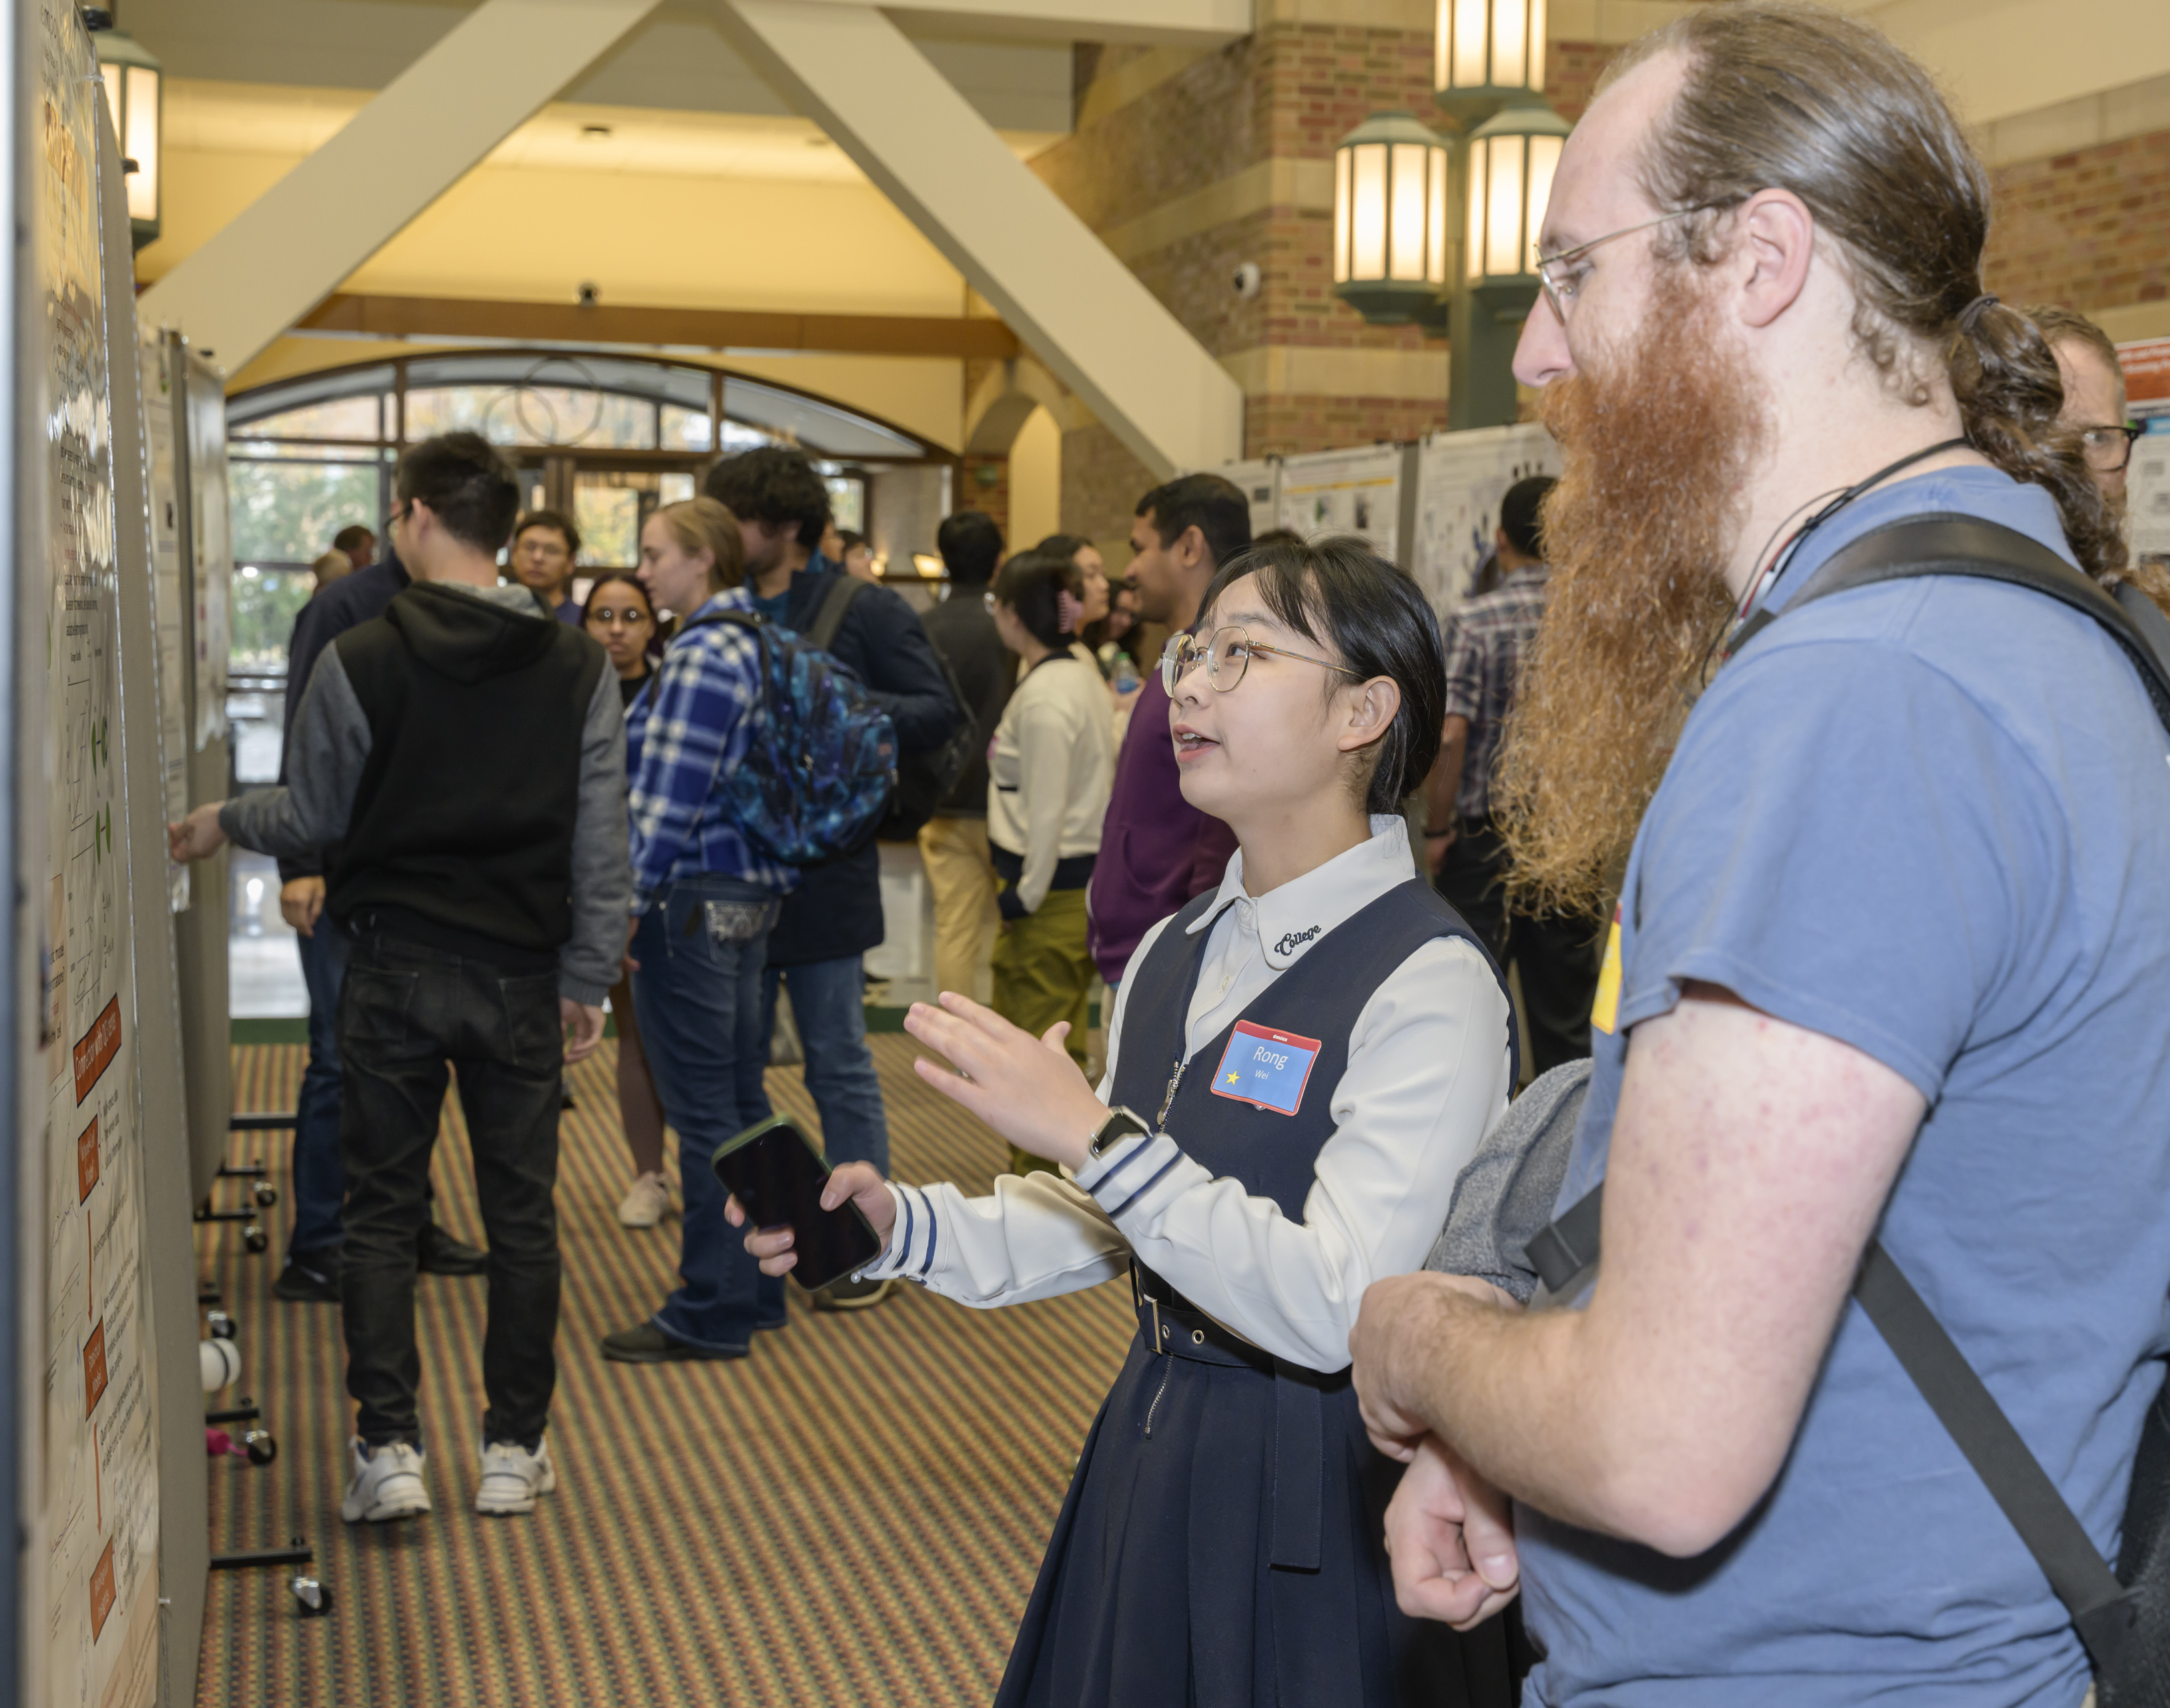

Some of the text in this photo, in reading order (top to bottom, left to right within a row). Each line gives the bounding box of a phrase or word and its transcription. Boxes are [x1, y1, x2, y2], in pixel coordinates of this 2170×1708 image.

[1274, 925, 1322, 956] College
[75, 1042, 95, 1081] Connection
[95, 1026, 103, 1056] with
[1253, 1045, 1289, 1070] Rong
[1254, 1069, 1269, 1080] Wei
